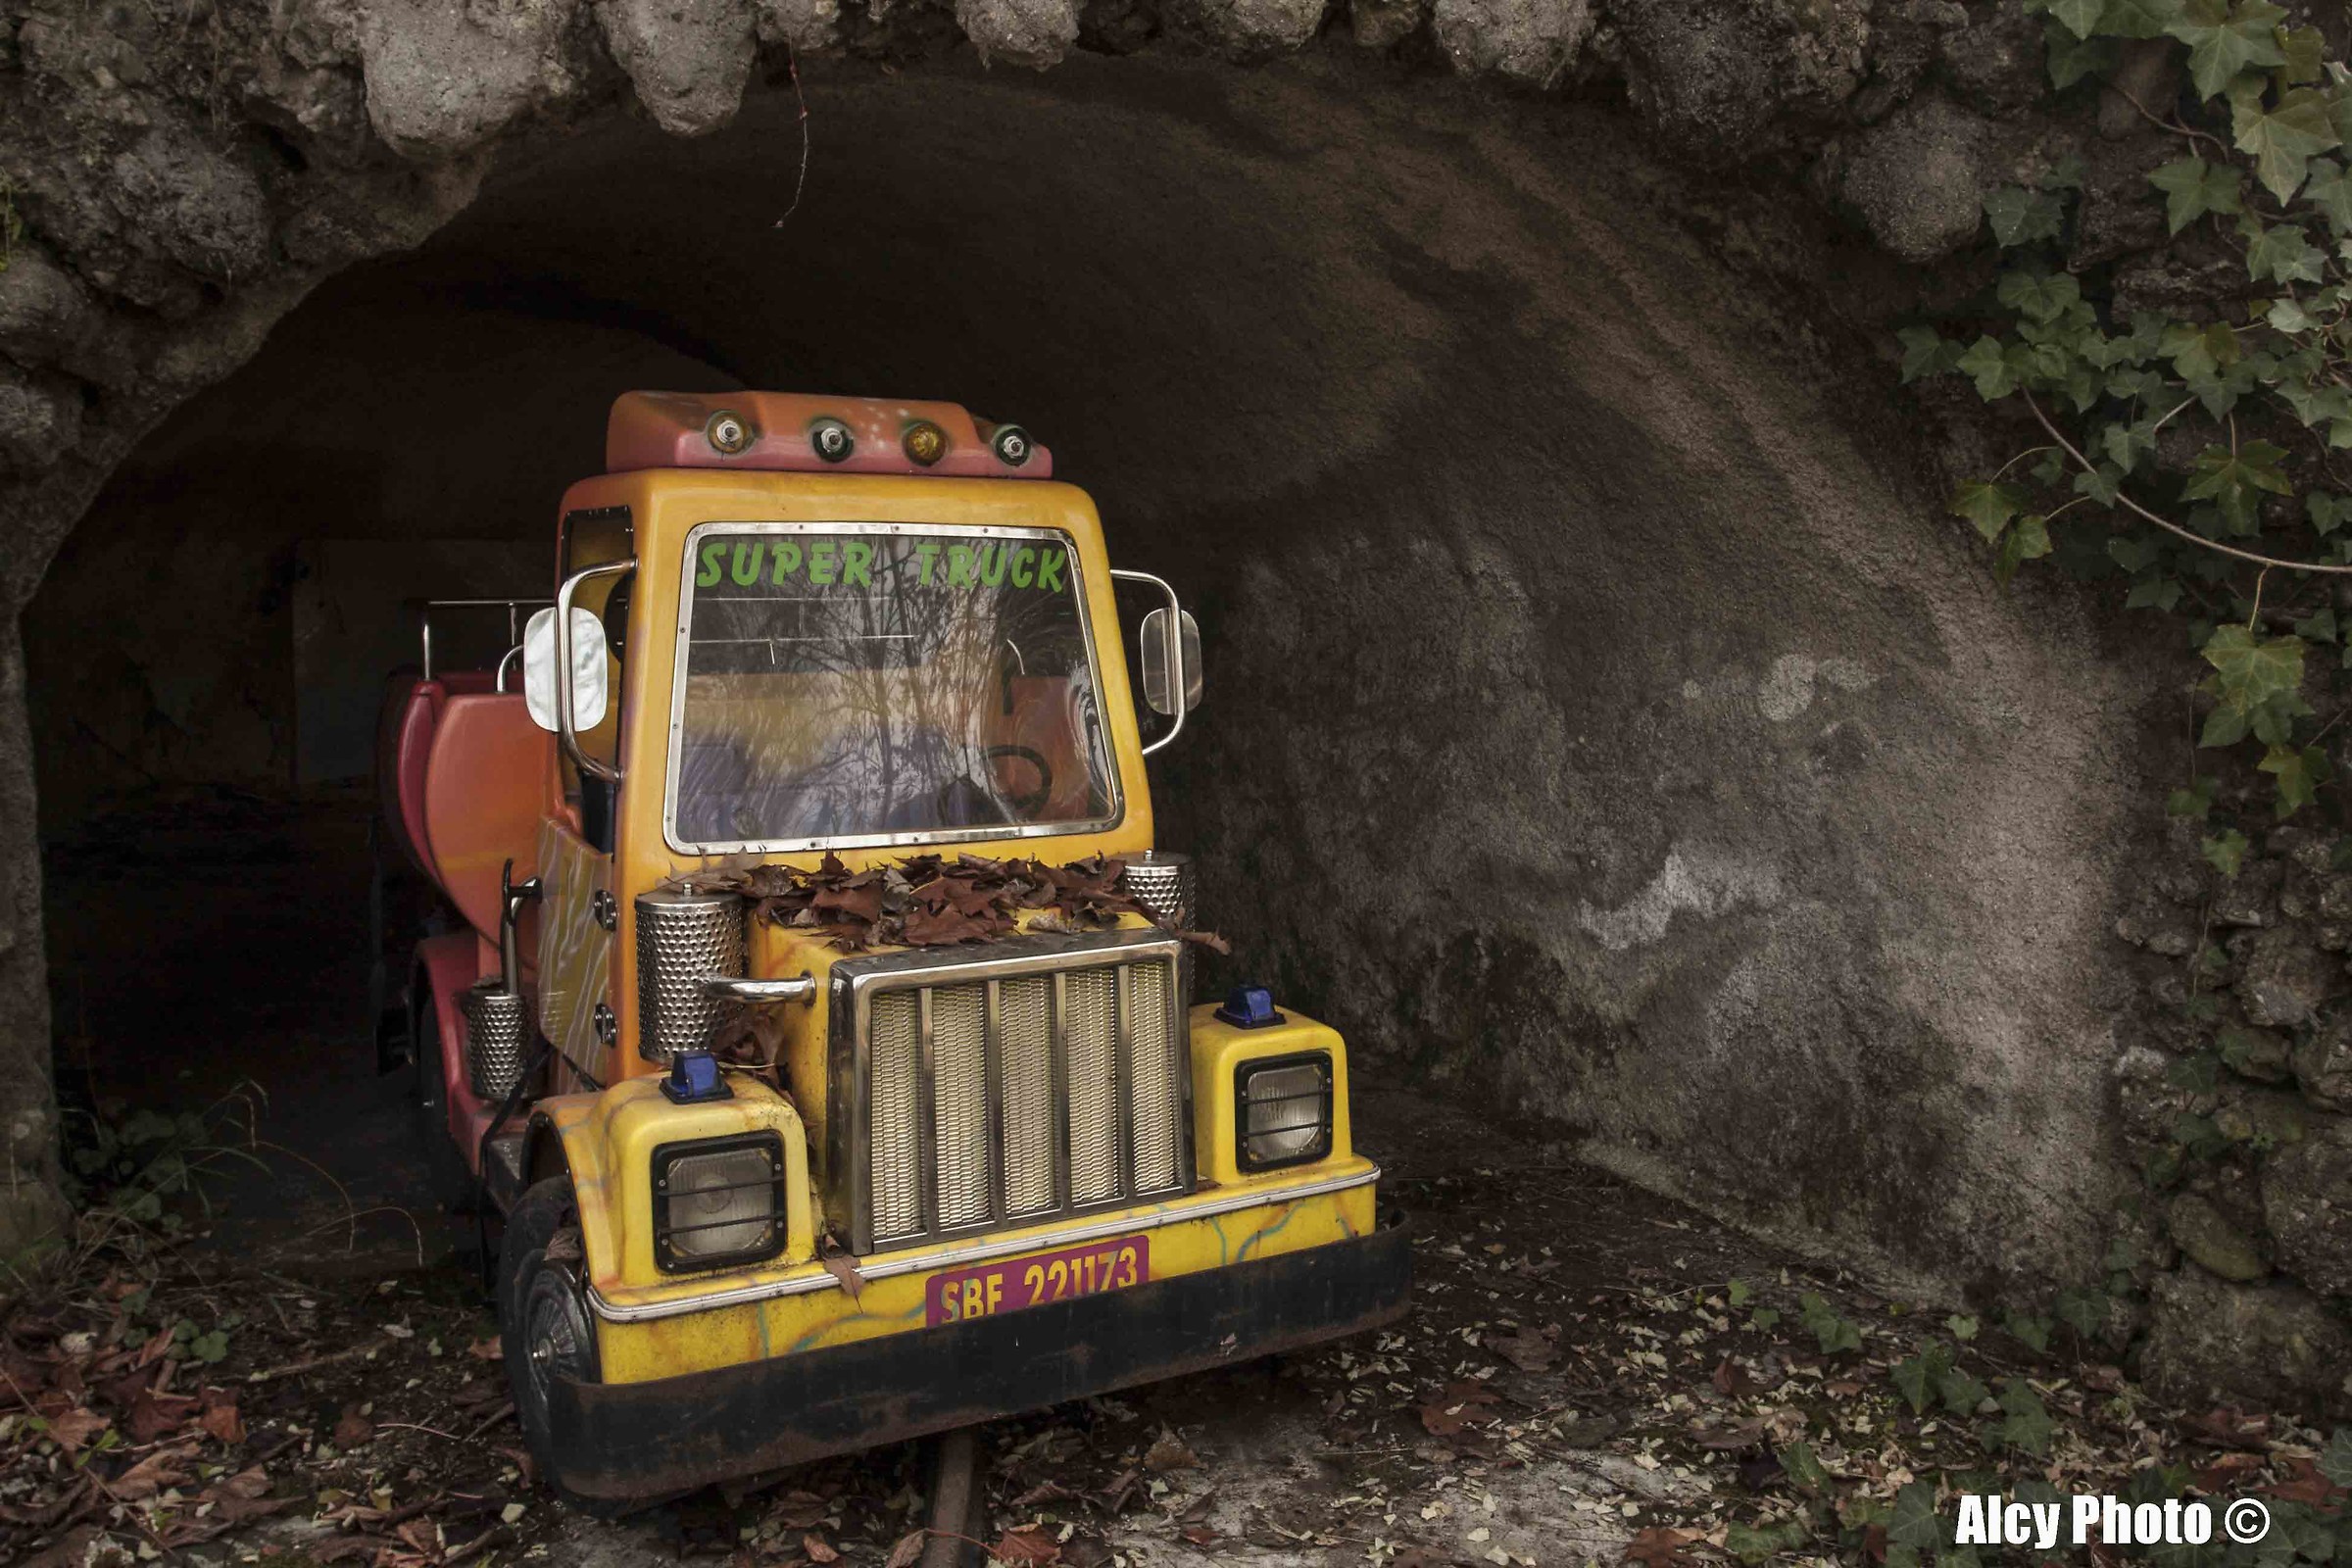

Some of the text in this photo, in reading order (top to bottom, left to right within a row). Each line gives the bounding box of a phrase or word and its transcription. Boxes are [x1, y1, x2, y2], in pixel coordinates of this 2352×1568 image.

[696, 541, 1067, 593] SUPER TRUCK
[941, 1246, 1138, 1323] SBF 221173
